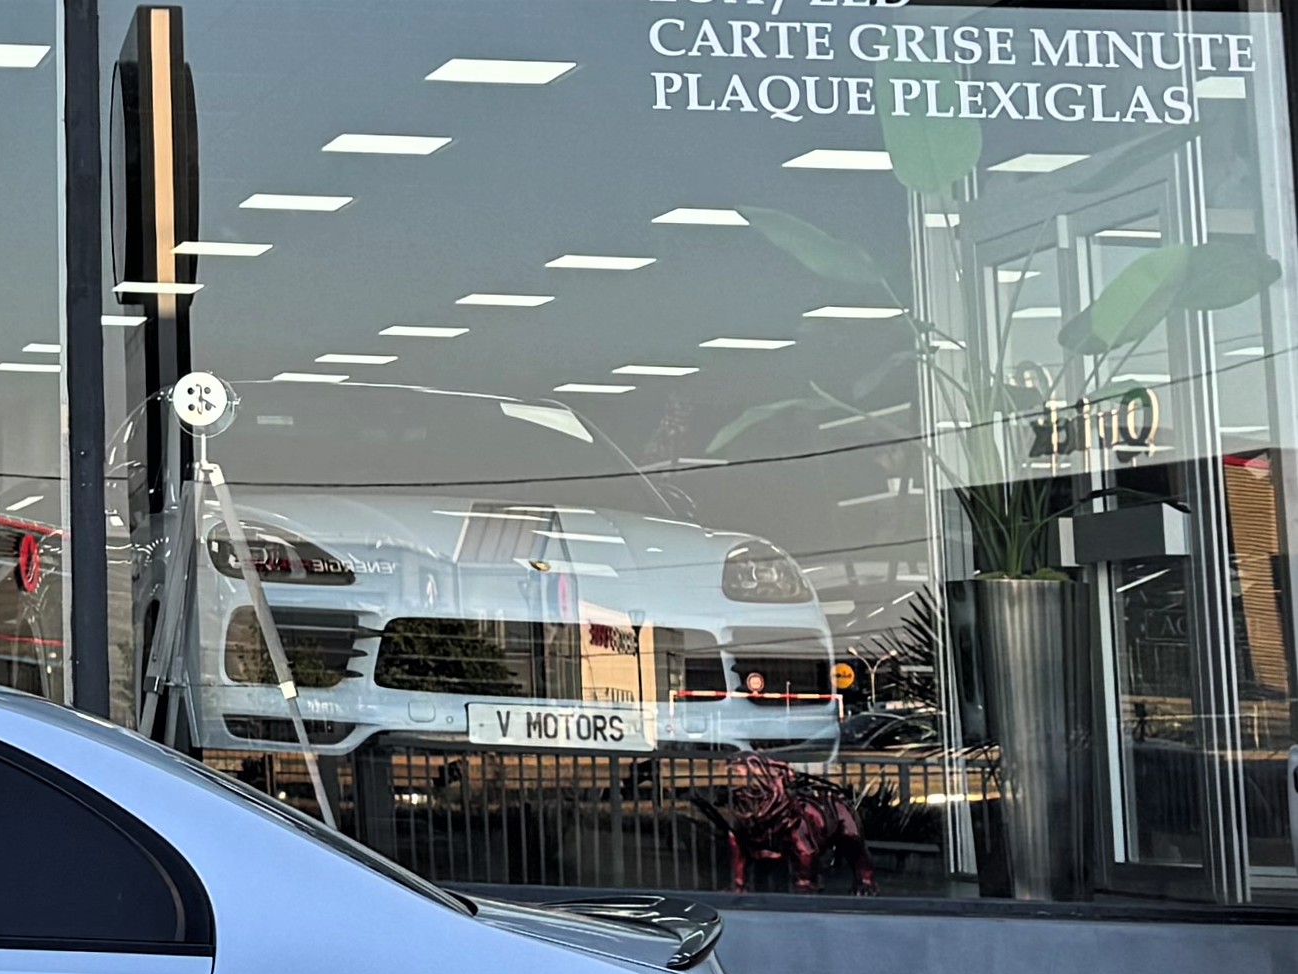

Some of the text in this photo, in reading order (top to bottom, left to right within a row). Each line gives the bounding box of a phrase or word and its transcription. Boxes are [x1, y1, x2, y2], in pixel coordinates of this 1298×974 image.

[649, 18, 1256, 72] CARTE GRISE MINUTE
[651, 72, 1192, 125] PLAQUE PLEXIGLAS
[497, 710, 624, 742] V MOTORS
